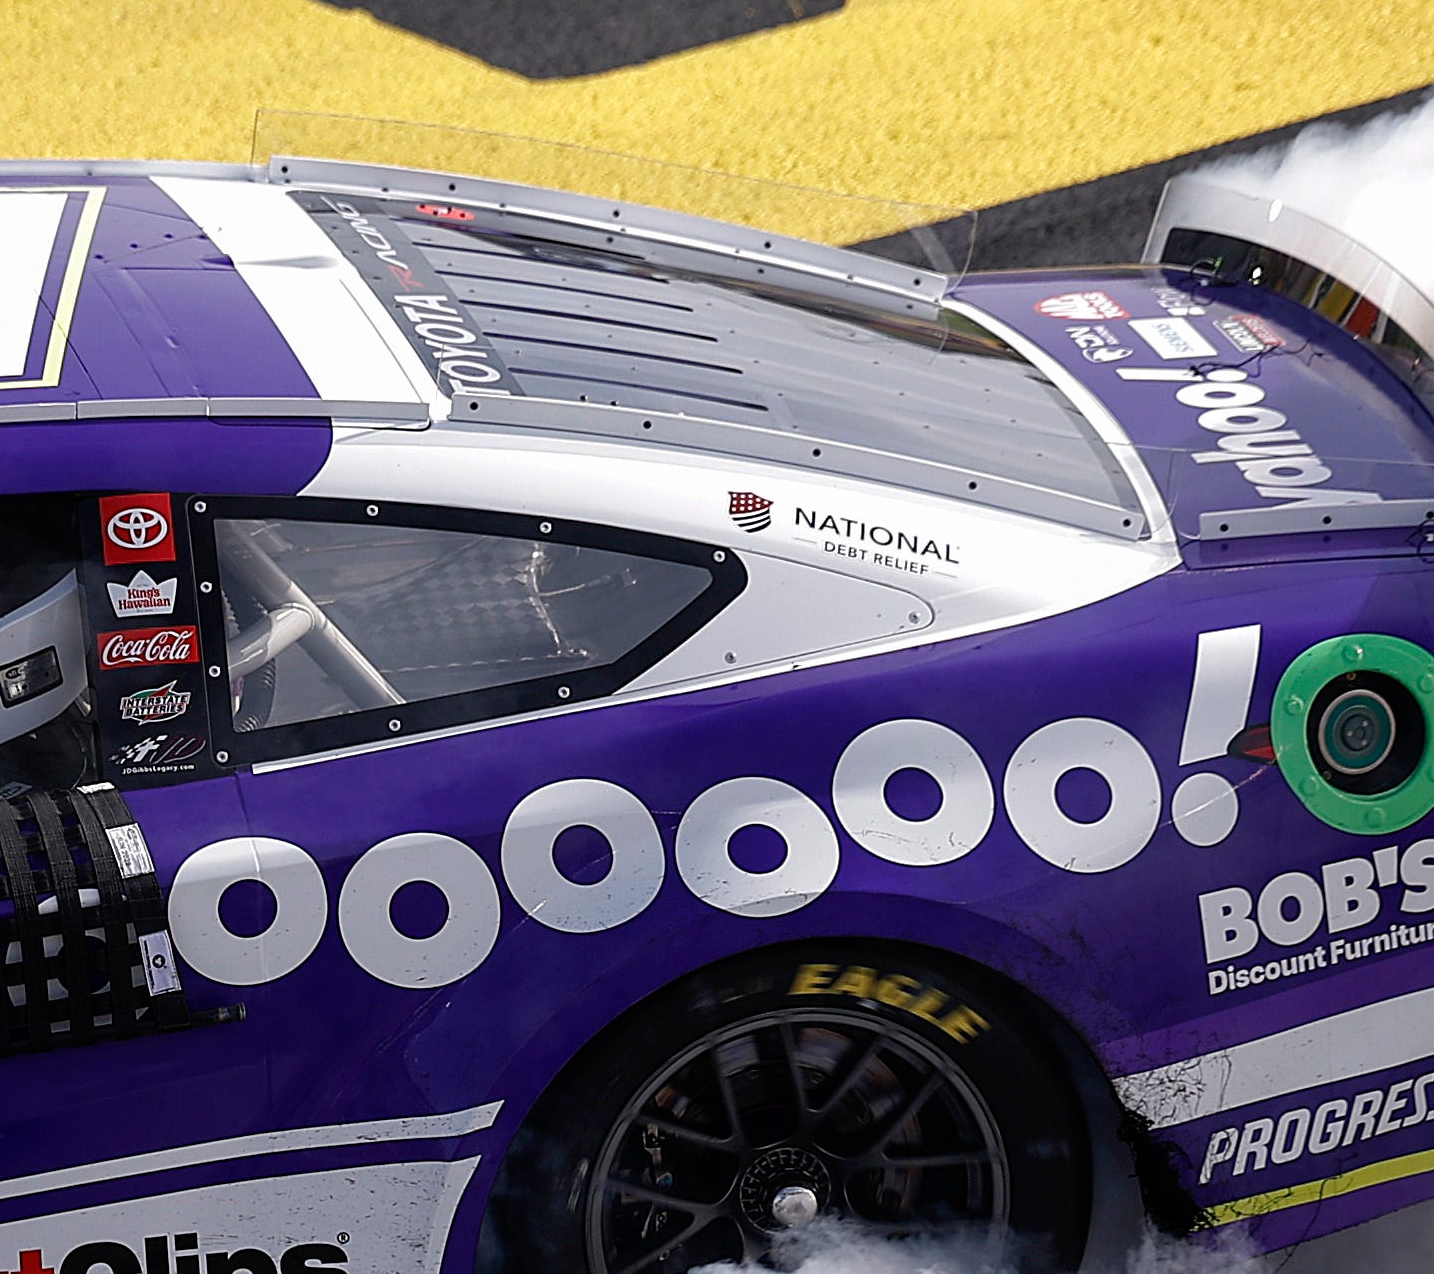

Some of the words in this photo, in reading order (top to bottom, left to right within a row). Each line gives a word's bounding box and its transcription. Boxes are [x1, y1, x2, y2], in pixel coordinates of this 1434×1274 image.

[321, 196, 426, 293] RACING
[394, 295, 511, 395] TOYOTA
[795, 507, 960, 564] NATIONAL
[824, 540, 868, 561] DEBT
[873, 552, 930, 575] RELIEF
[118, 597, 171, 610] Hawaiian
[127, 587, 160, 600] King's
[122, 693, 190, 709] INTERSTATE
[124, 705, 185, 718] BATTERIES
[122, 764, 195, 775] JDGibbsLegacy.com
[1208, 945, 1327, 997] Discount
[786, 963, 992, 1045] EAGLE
